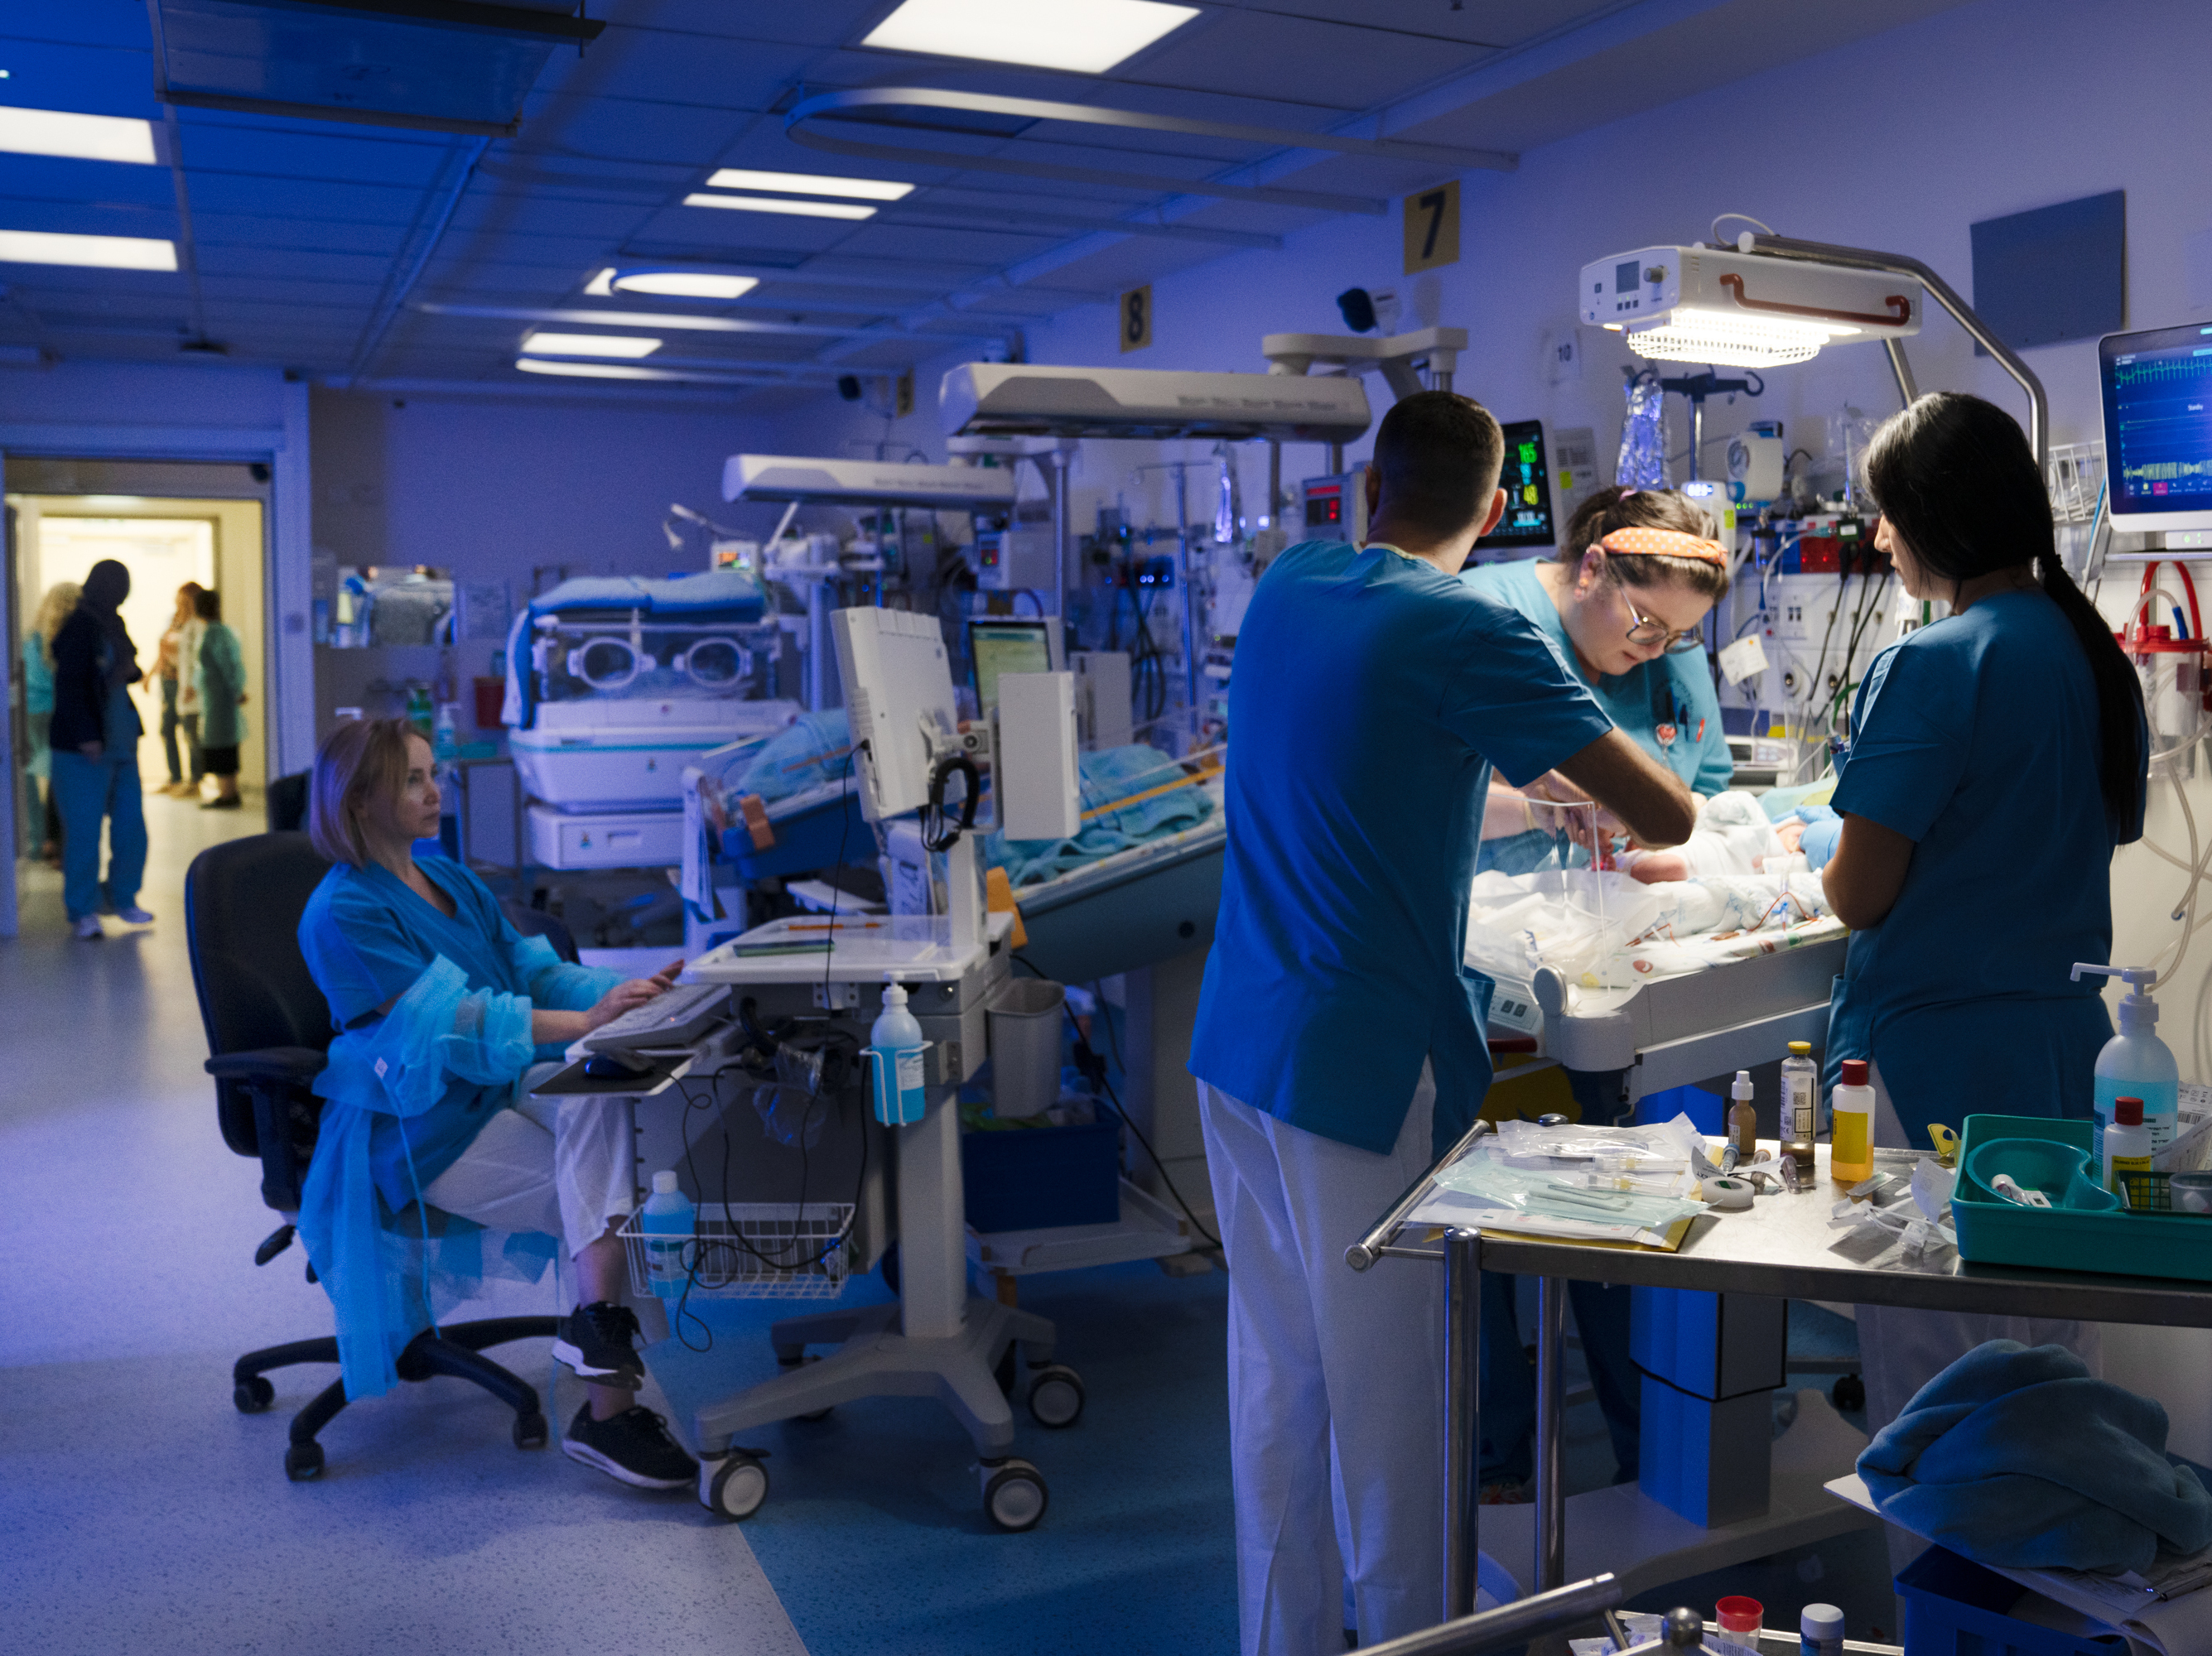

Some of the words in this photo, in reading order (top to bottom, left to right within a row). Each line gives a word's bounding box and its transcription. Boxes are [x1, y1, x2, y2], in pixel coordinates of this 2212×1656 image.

[1419, 190, 1446, 260] 7
[1126, 291, 1145, 344] 8
[1558, 343, 1572, 363] 10
